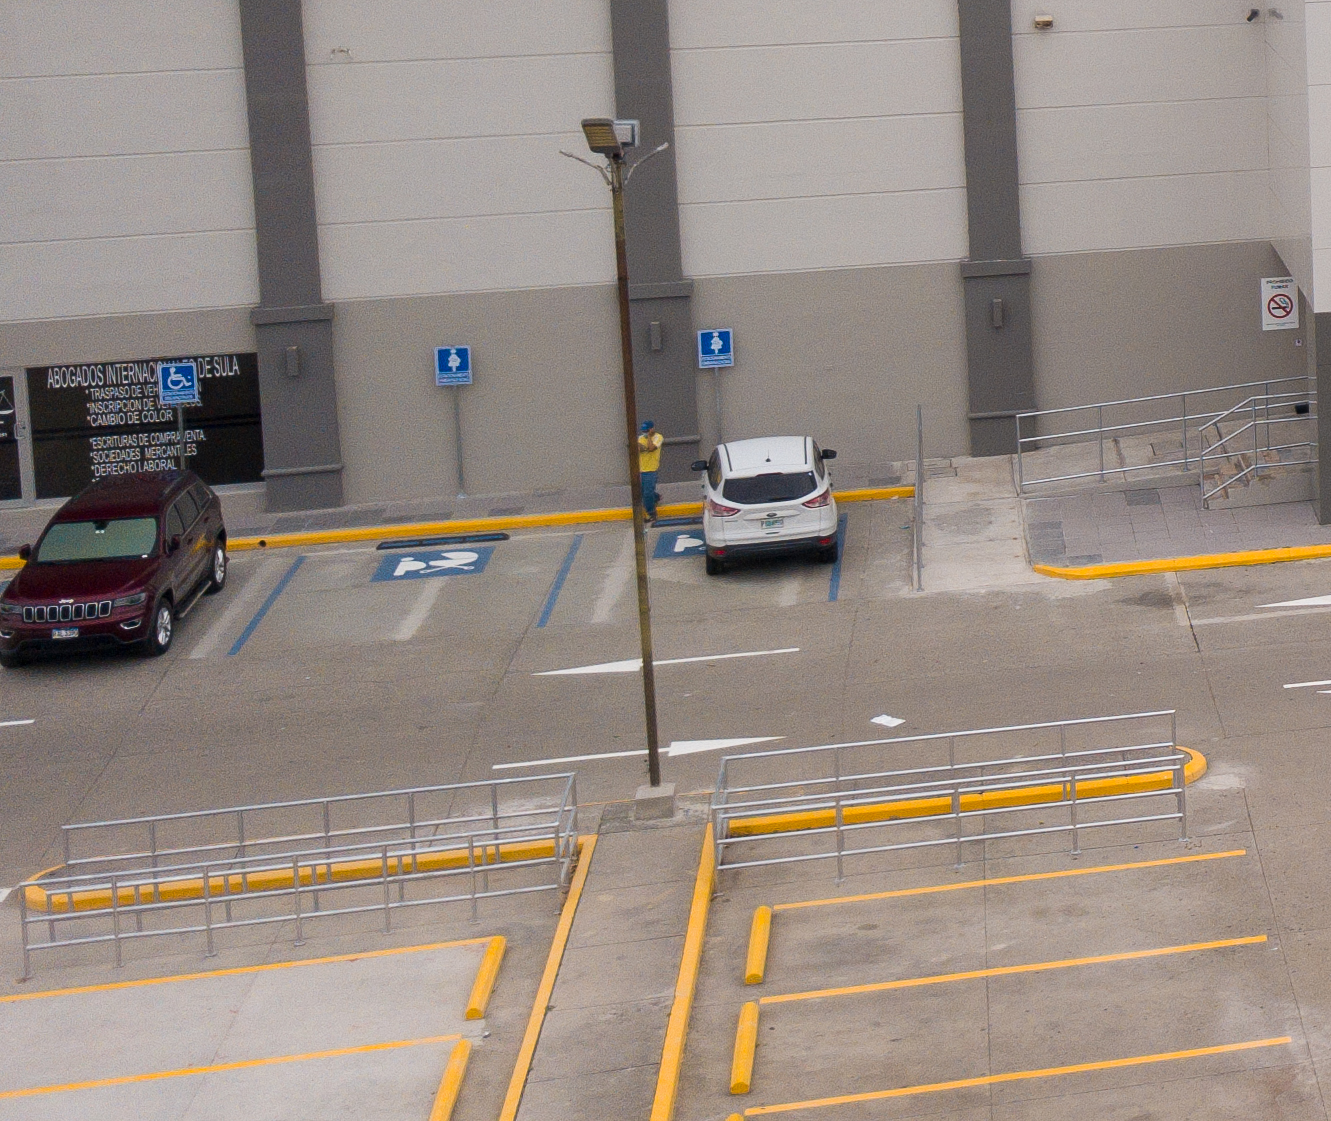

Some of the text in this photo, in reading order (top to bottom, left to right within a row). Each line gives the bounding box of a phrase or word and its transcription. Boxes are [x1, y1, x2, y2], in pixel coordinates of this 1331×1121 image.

[47, 365, 104, 389] ABOGADOS
[198, 359, 212, 378] DE
[214, 356, 240, 377] SULA
[90, 387, 130, 400] TRASPASO
[132, 385, 142, 396] DE
[143, 398, 155, 410] DE
[127, 412, 140, 424] DE
[142, 409, 173, 423] COLOR
[139, 434, 149, 446] DE
[138, 459, 177, 473] LABORAL
